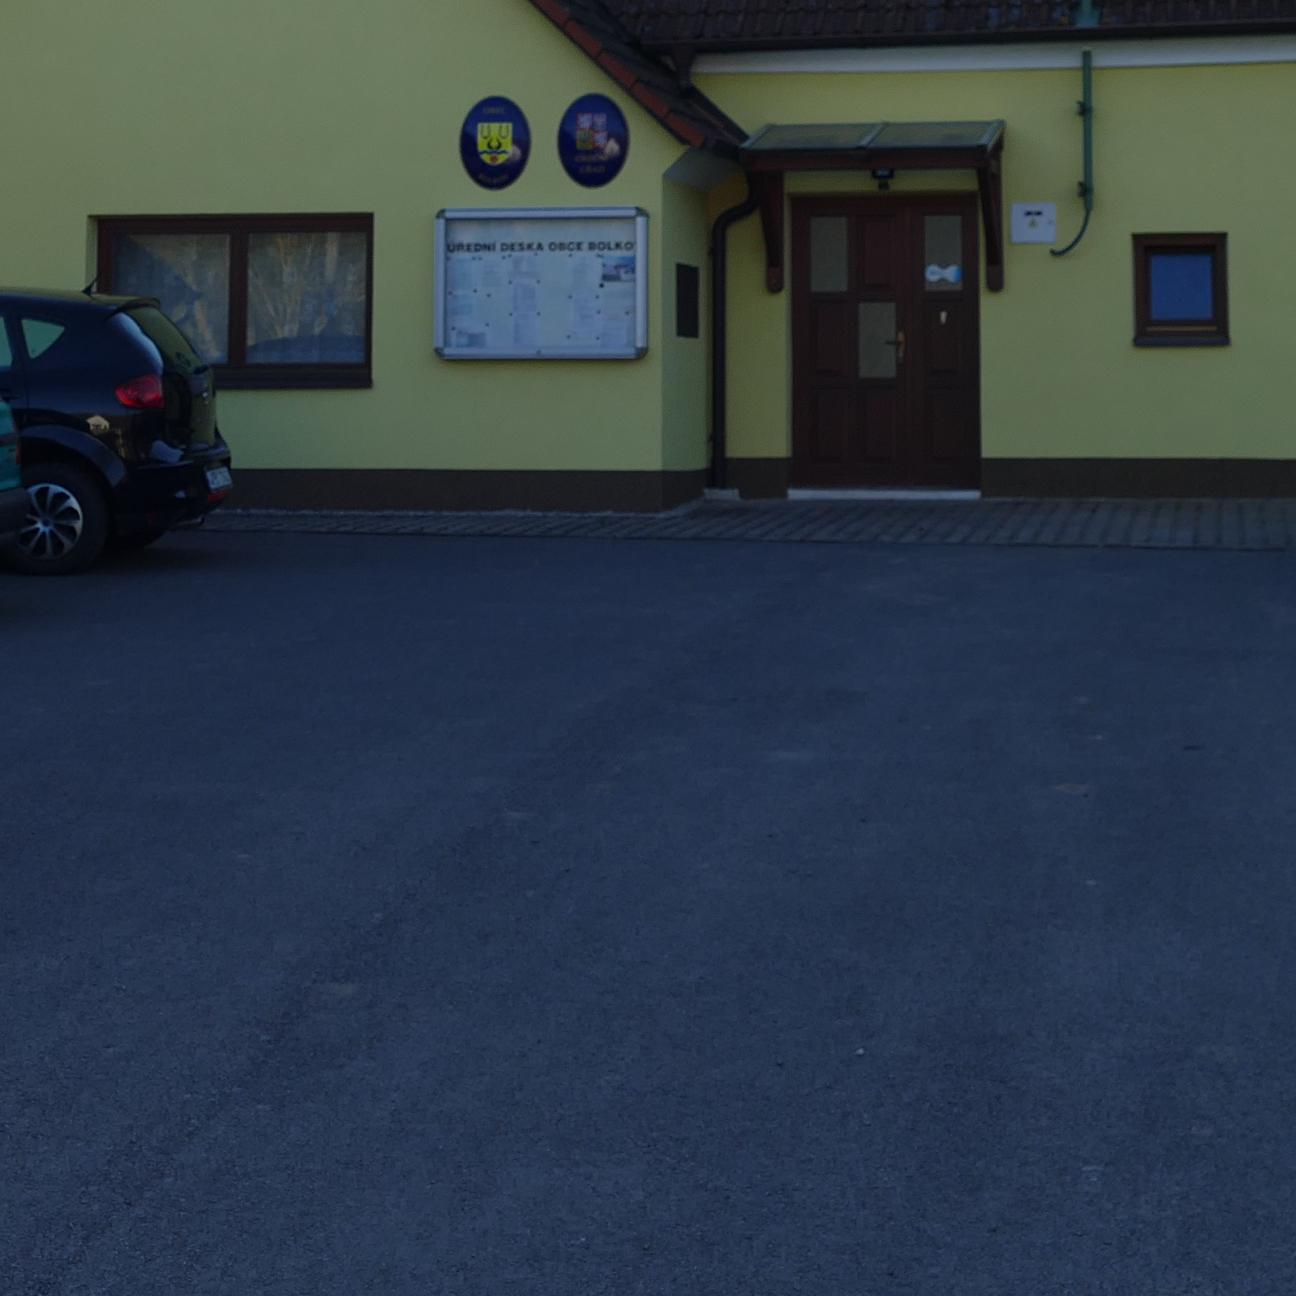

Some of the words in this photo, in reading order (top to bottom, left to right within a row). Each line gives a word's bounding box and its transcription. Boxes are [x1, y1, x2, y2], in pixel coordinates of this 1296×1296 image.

[500, 241, 544, 252] DESKA
[548, 241, 583, 252] OBCE
[588, 241, 636, 252] BOLKO
